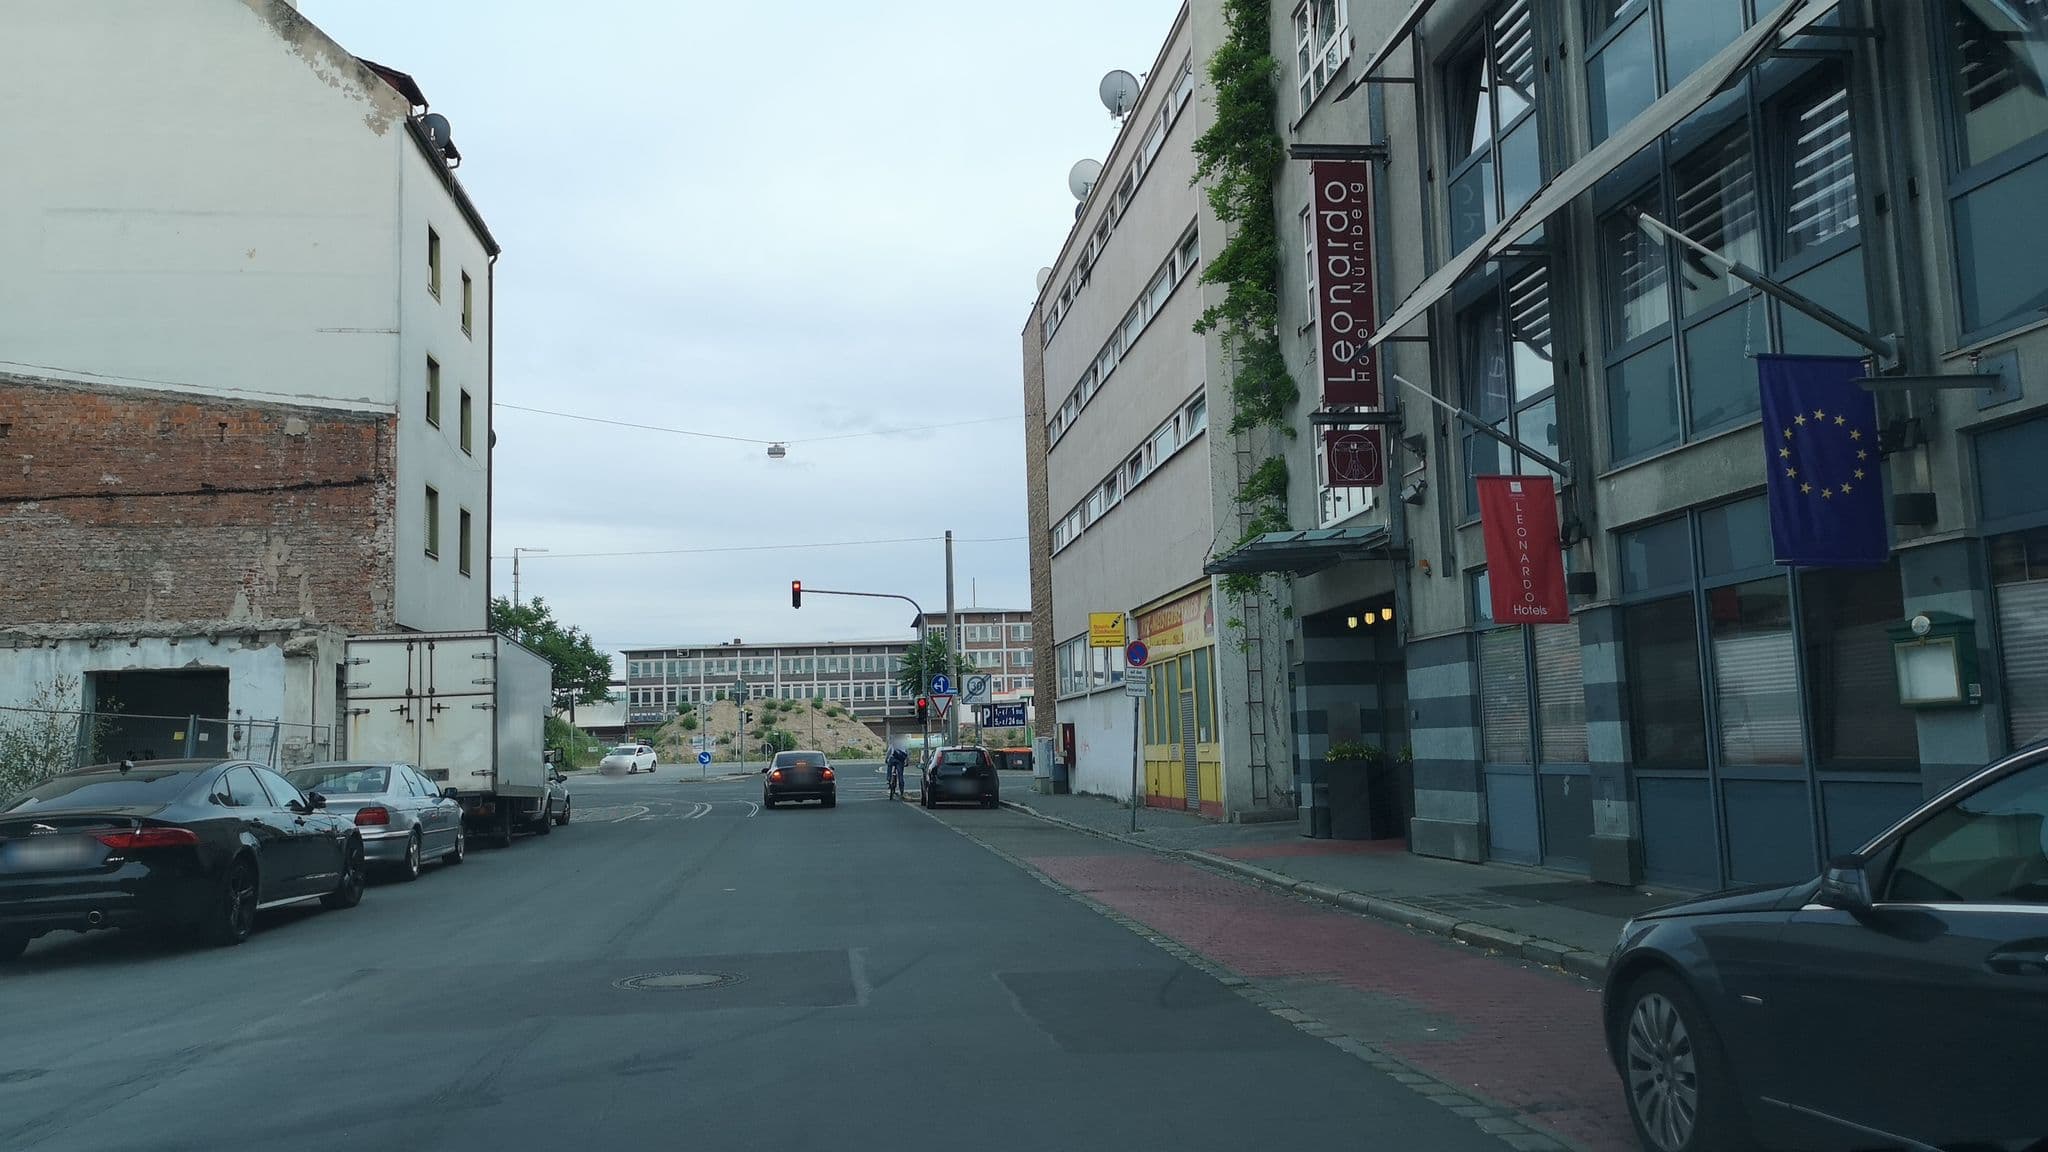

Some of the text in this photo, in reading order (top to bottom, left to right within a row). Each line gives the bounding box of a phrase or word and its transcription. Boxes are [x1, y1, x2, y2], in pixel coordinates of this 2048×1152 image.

[1319, 181, 1356, 382] Leonardo
[1350, 183, 1371, 382] Hotel Nürnberg
[1515, 502, 1535, 602] LEONARDO
[1513, 604, 1548, 615] Hotels
[970, 681, 982, 691] 30
[983, 707, 990, 726] P
